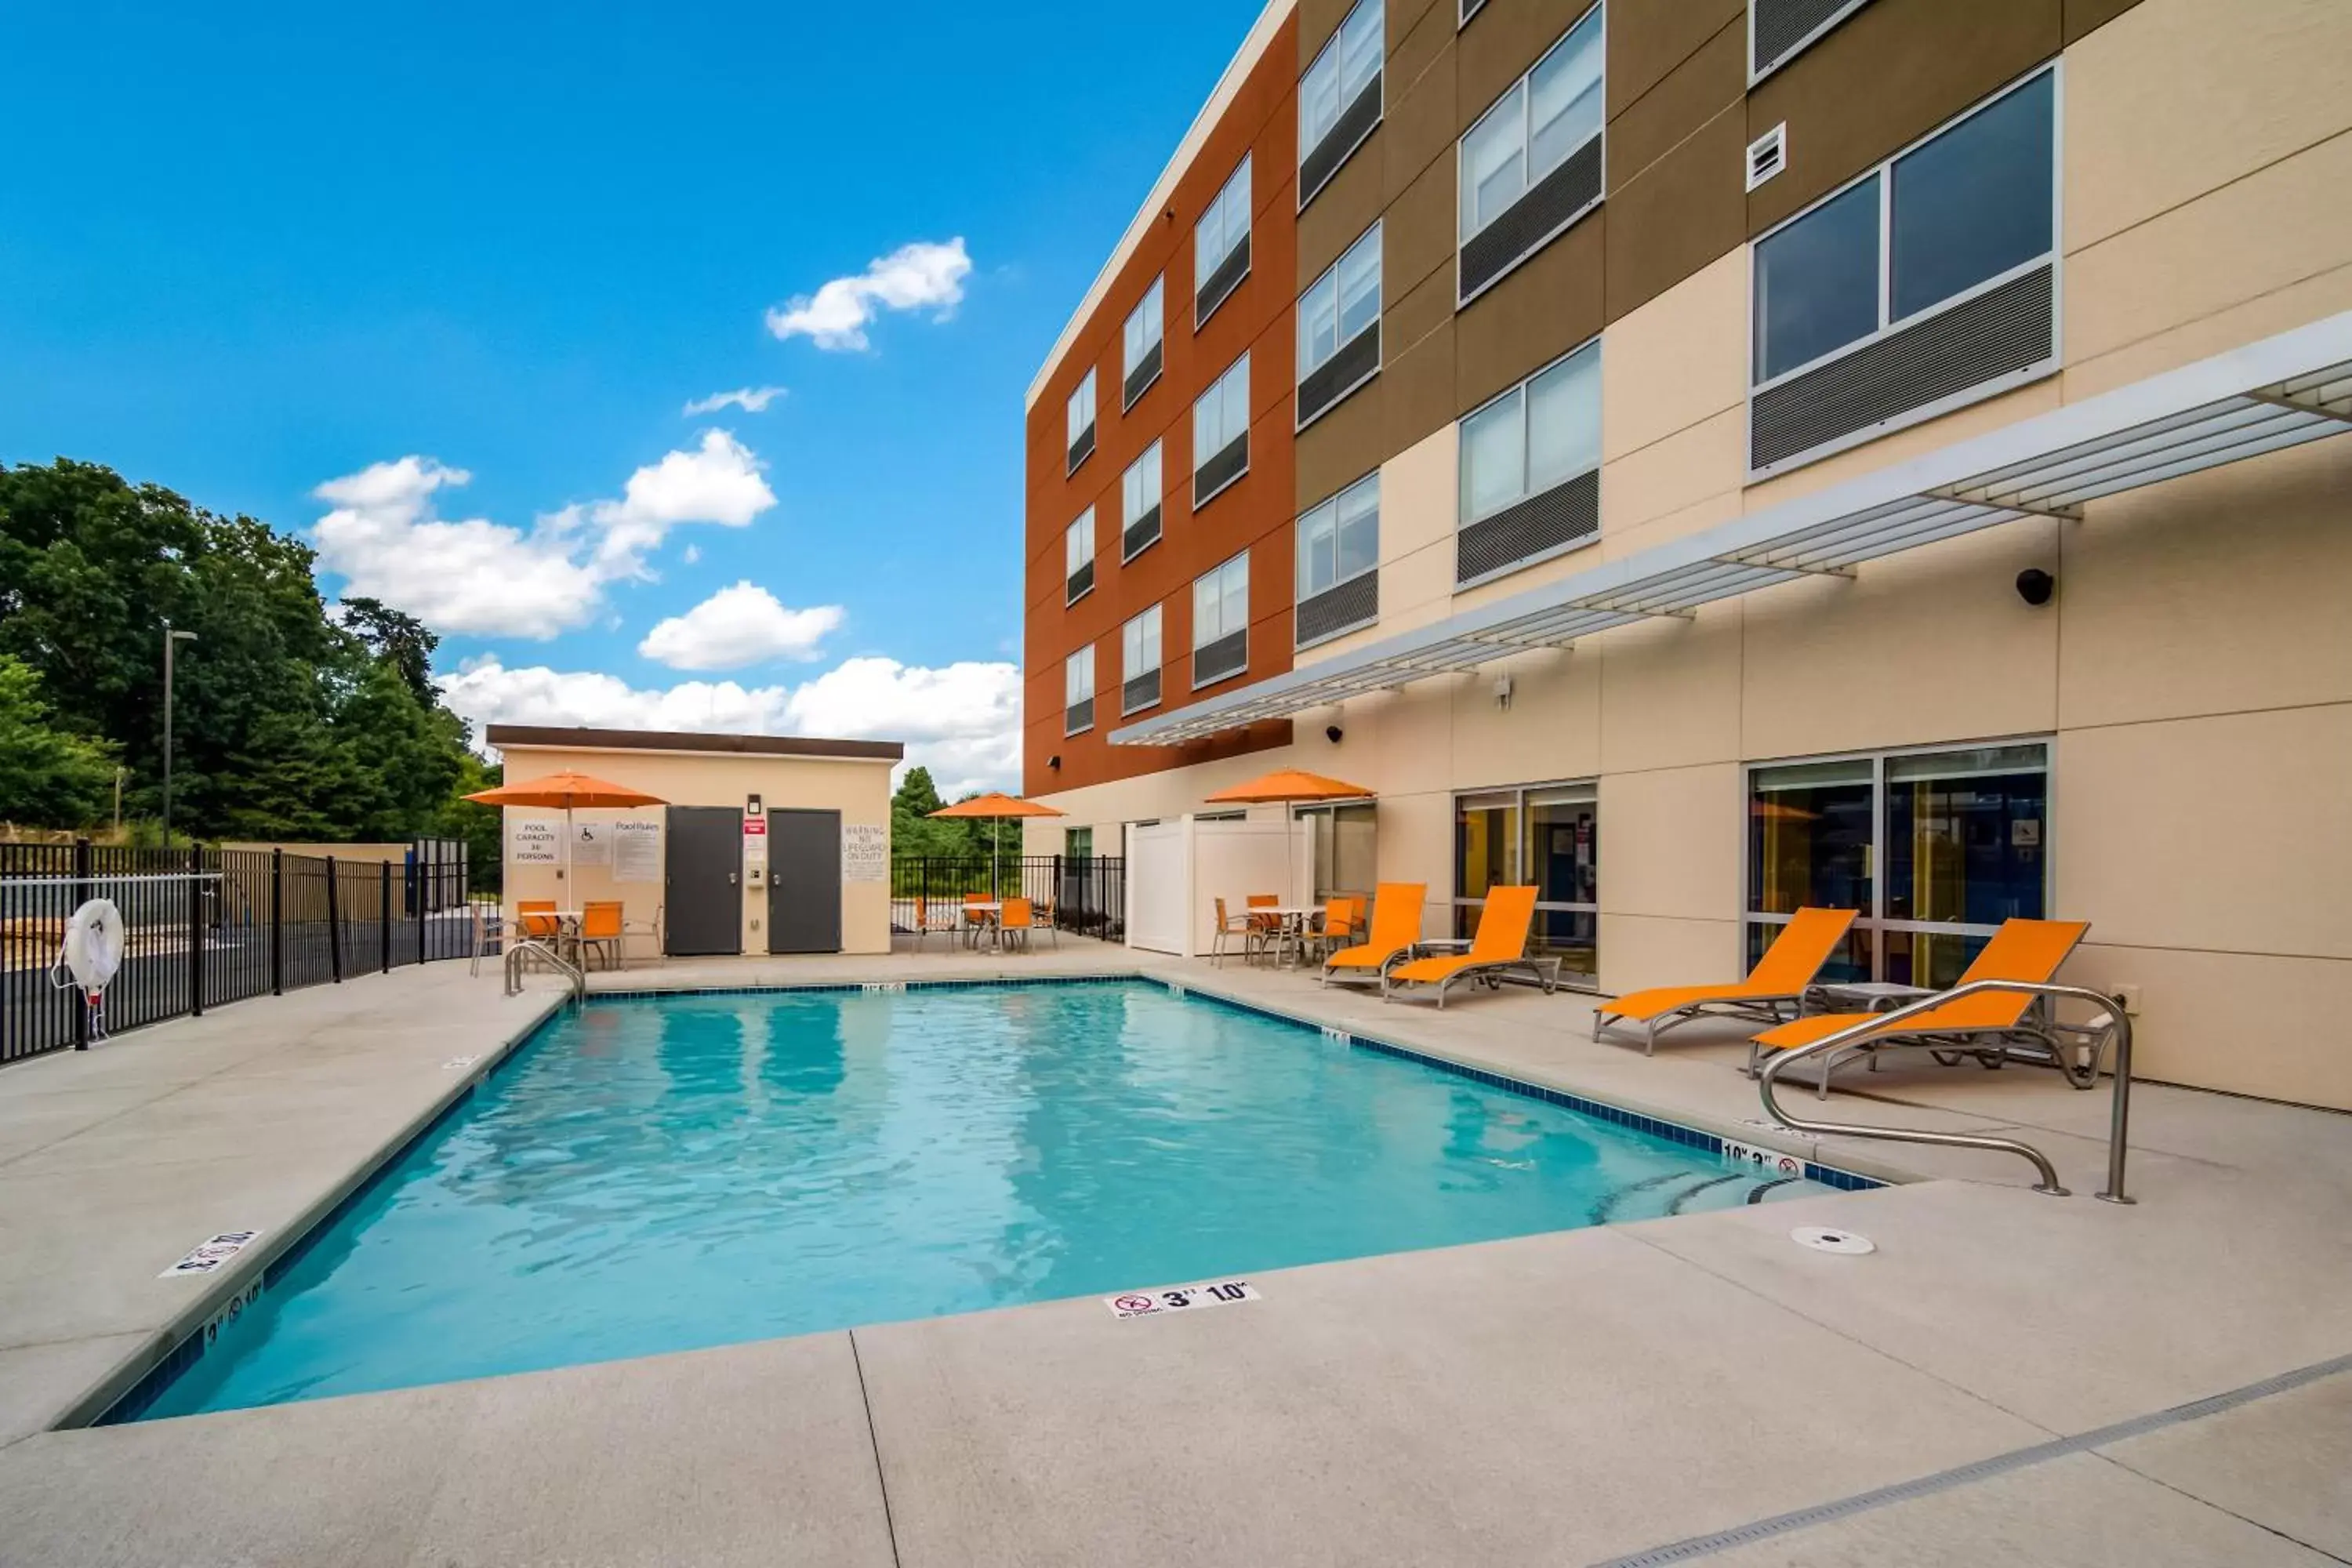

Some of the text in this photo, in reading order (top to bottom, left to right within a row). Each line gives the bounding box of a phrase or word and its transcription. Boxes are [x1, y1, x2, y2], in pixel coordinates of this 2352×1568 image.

[615, 822, 659, 830] Pool Rules
[843, 844, 887, 852] LIFEGUARD
